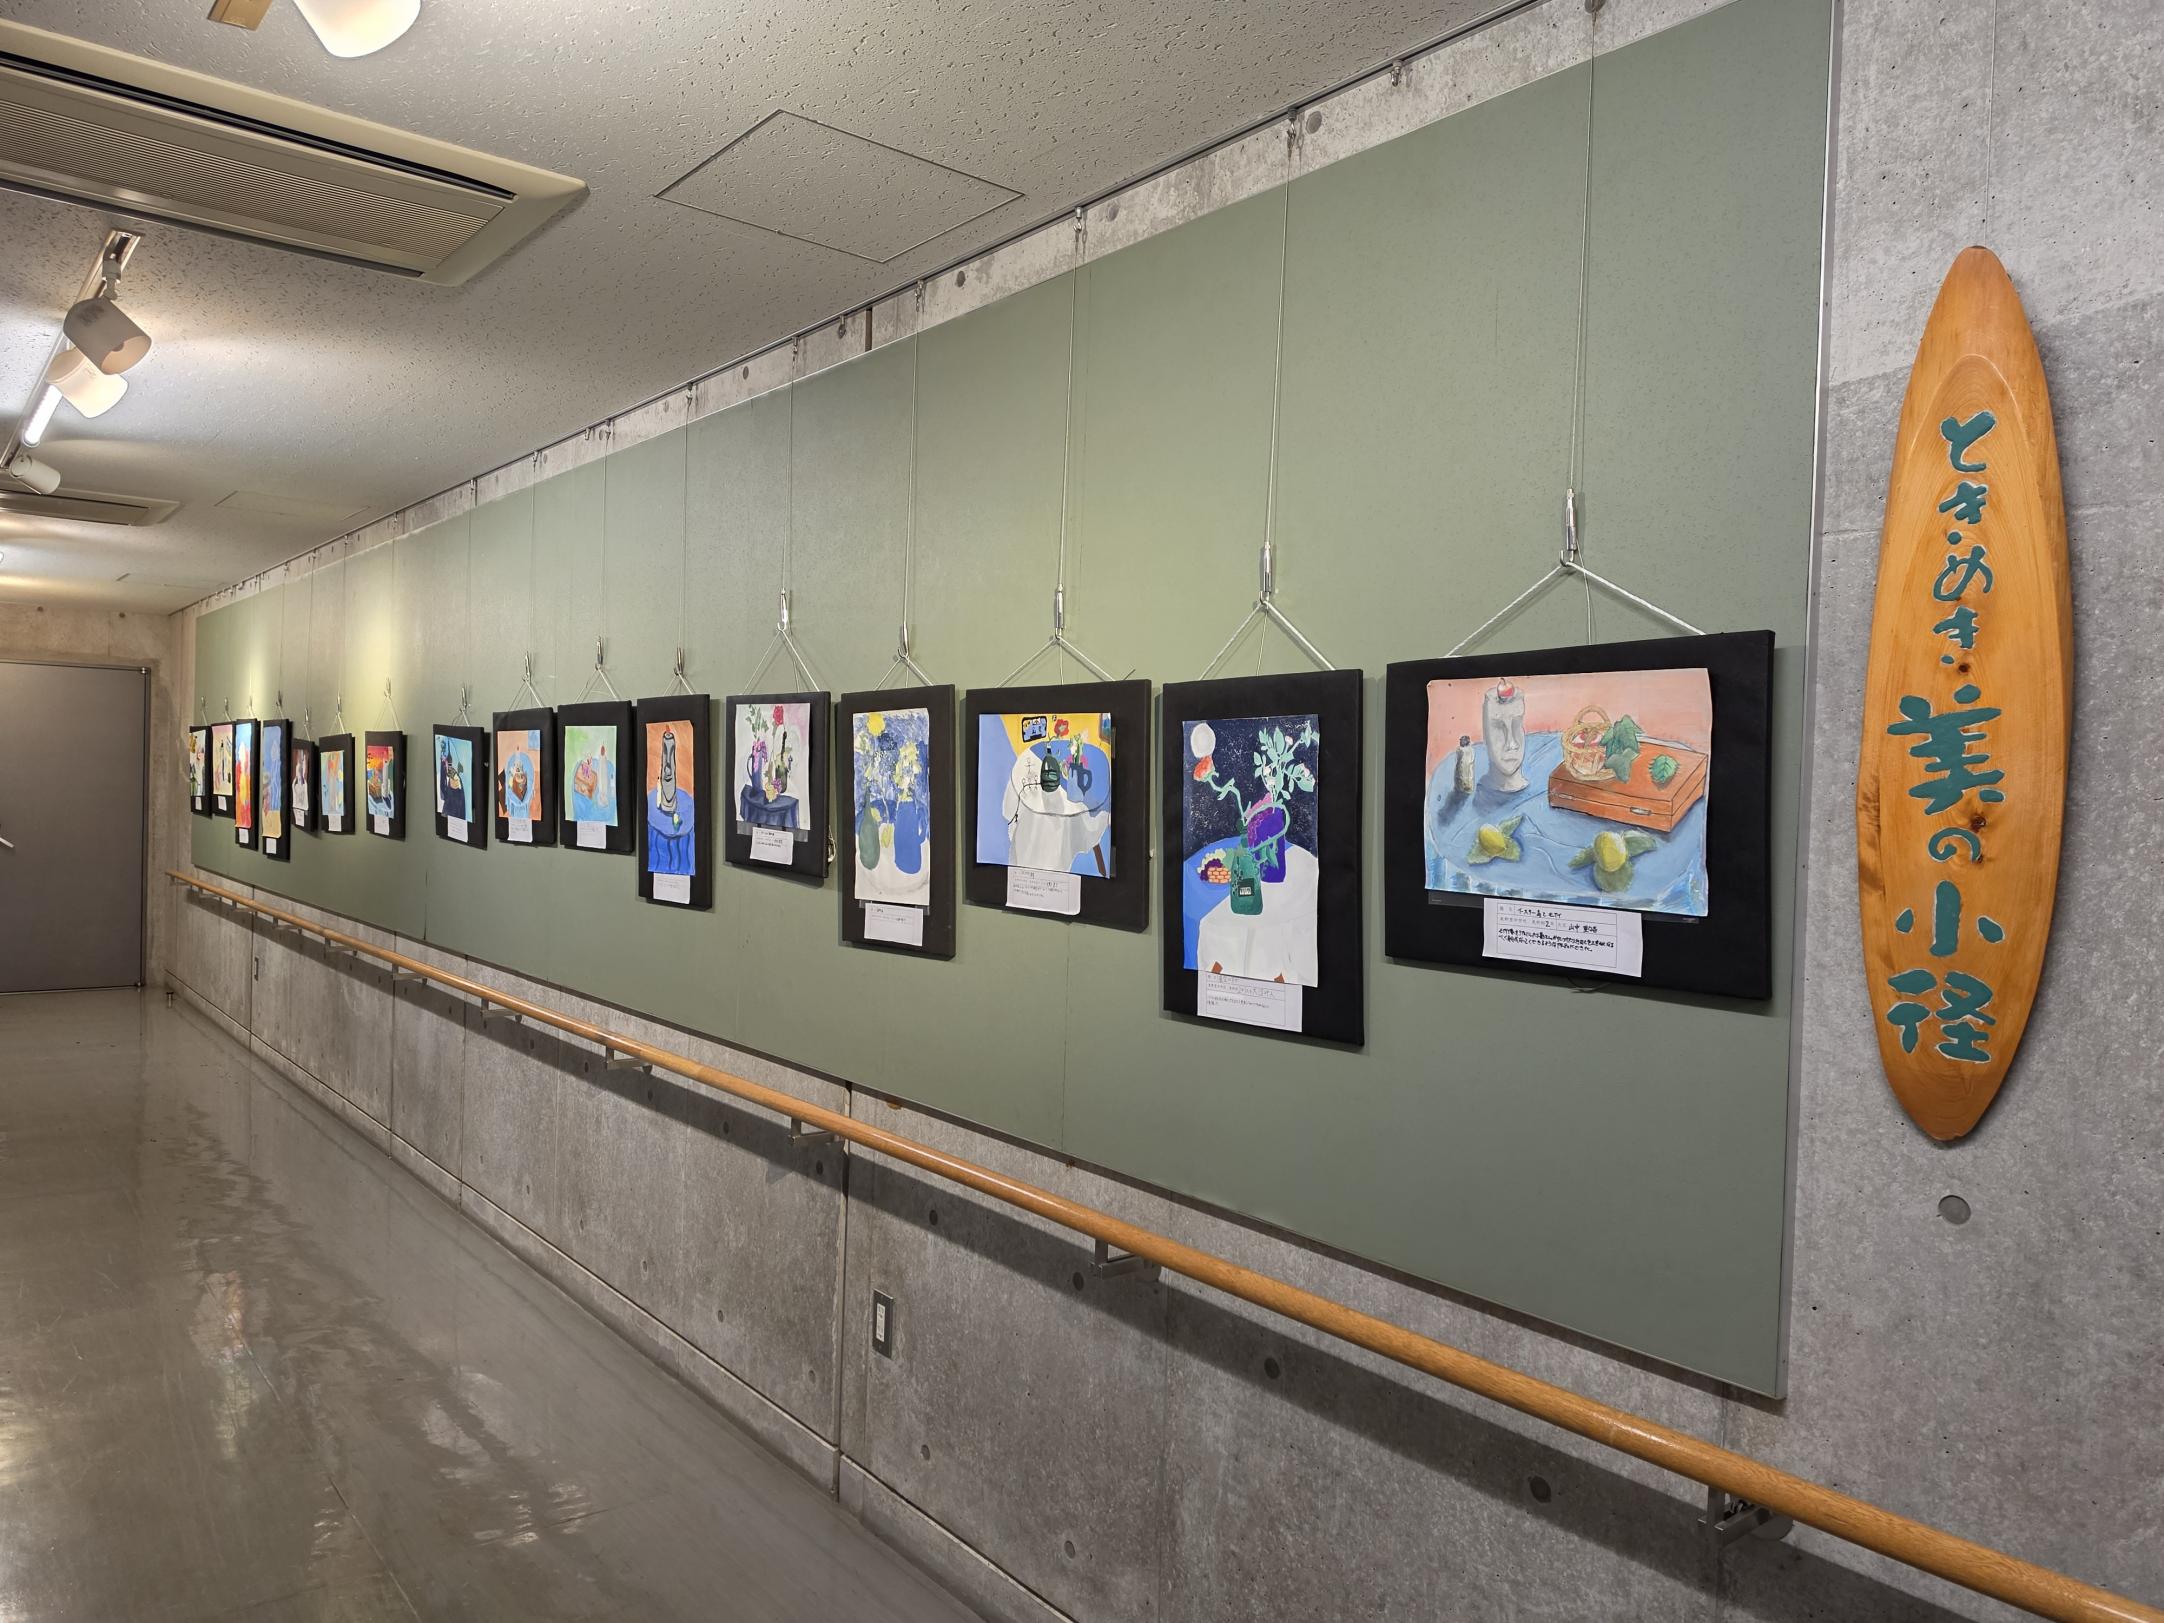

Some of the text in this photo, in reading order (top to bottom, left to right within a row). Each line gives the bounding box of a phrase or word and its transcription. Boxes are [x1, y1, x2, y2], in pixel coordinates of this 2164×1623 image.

[1887, 411, 2005, 1063] ときめき美の小径
